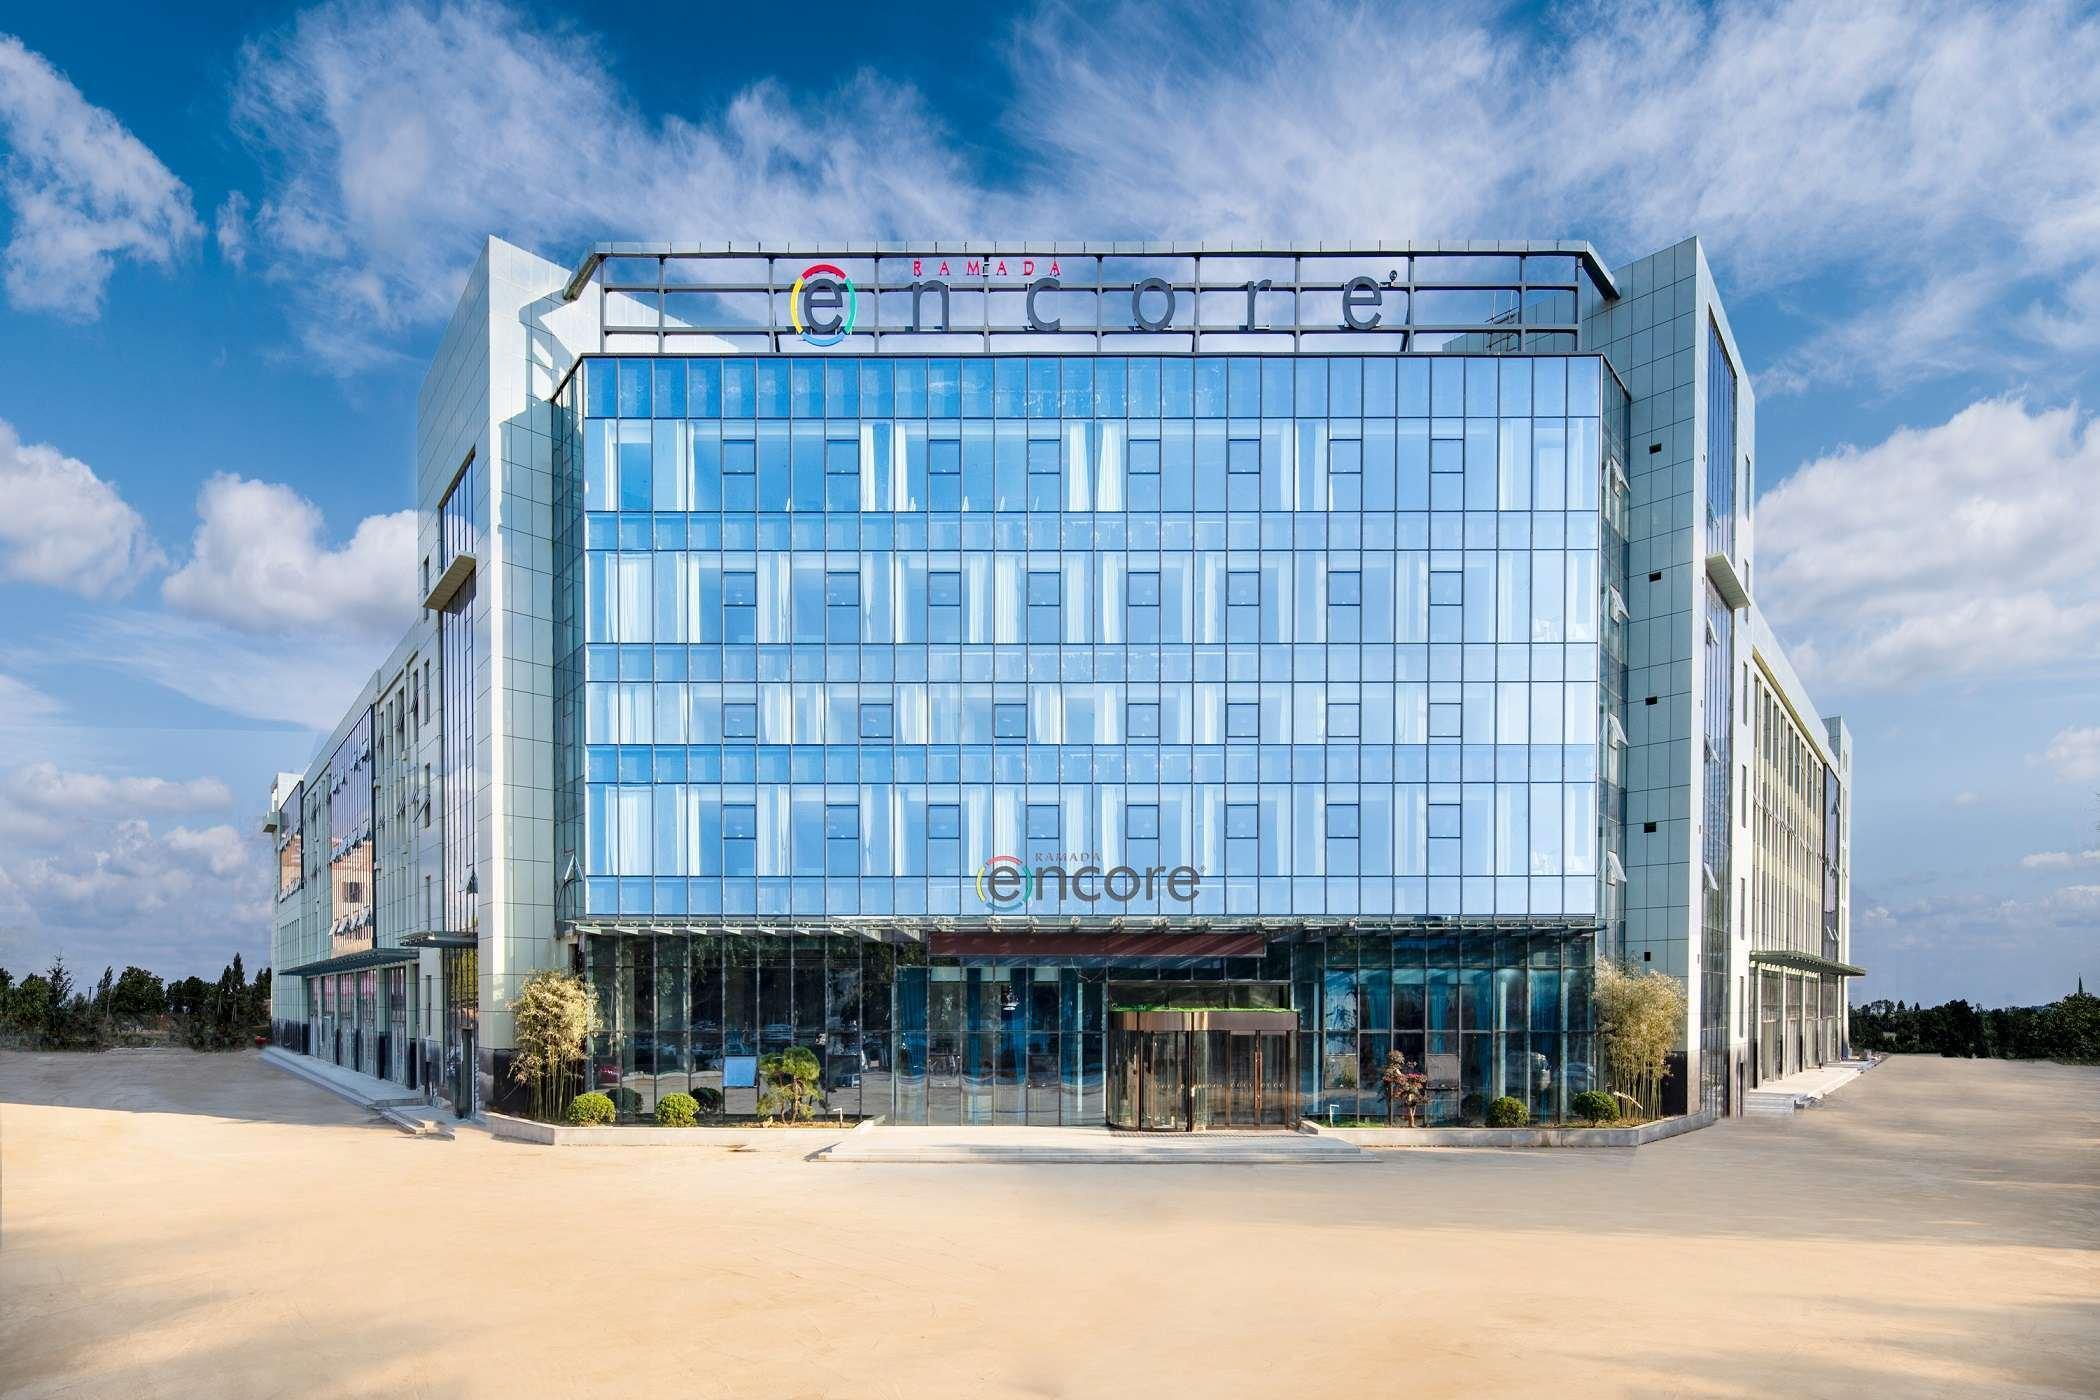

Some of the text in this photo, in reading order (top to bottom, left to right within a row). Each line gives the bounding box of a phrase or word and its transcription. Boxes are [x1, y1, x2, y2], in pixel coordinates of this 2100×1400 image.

[913, 260, 1061, 277] RAMADA
[803, 275, 1383, 333] encore
[1035, 852, 1102, 862] RAMADA
[988, 865, 1201, 902] encore
